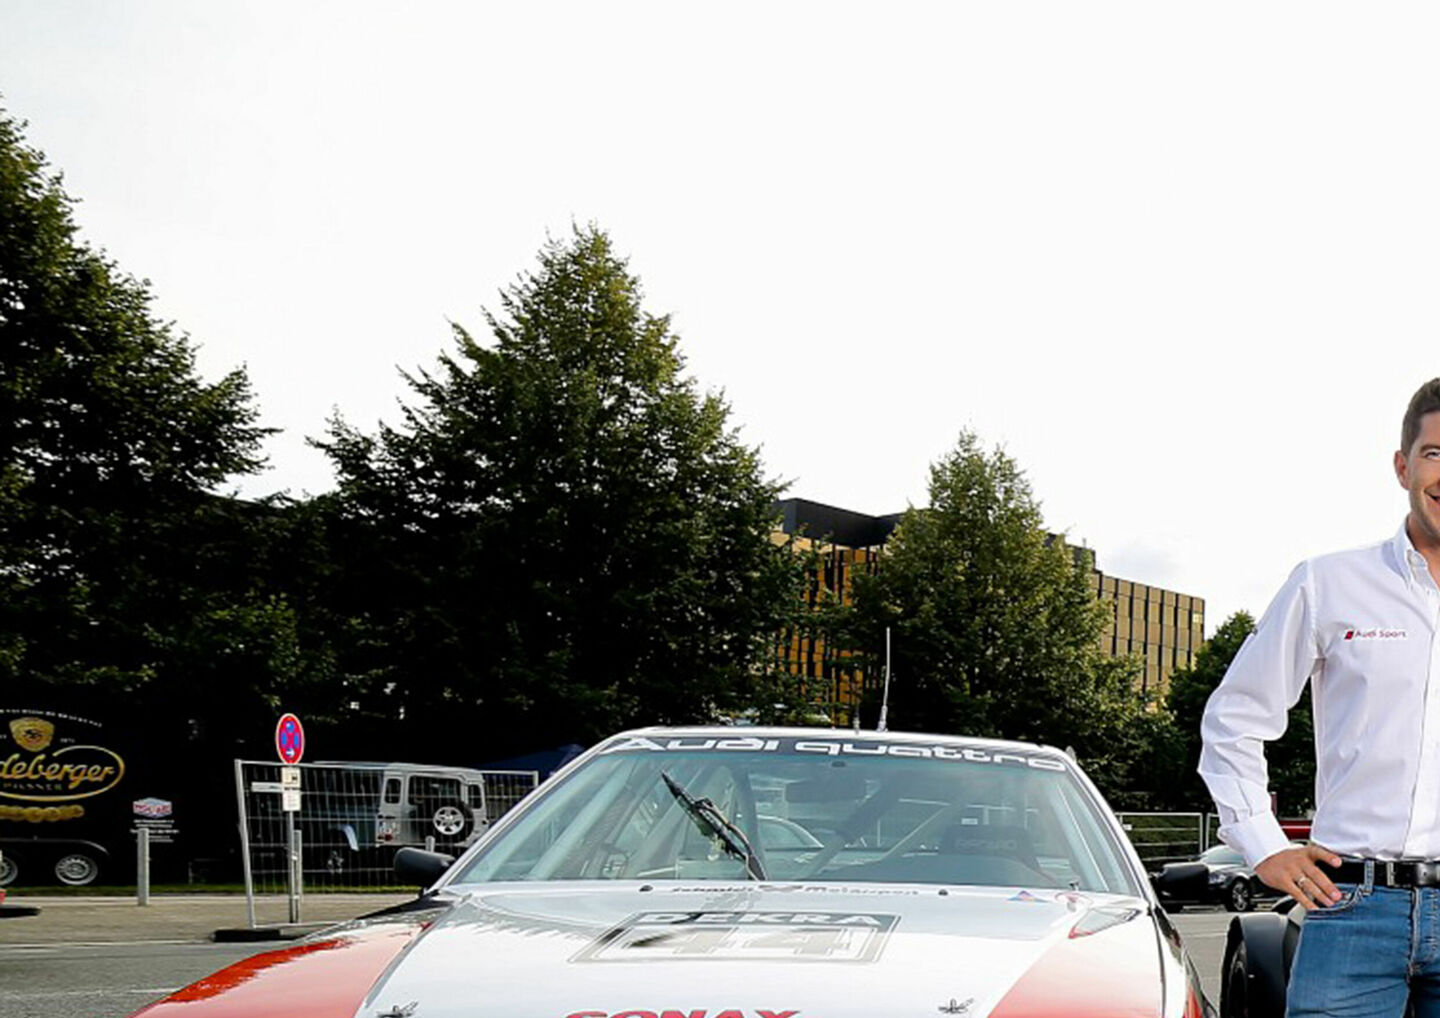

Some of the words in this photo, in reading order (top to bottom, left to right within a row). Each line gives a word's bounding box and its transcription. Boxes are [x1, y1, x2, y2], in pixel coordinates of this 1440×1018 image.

[1355, 629, 1376, 639] Audi
[1379, 628, 1406, 640] Sport
[608, 737, 779, 753] Audi
[795, 741, 1065, 771] quattro
[636, 911, 882, 925] DEKRA
